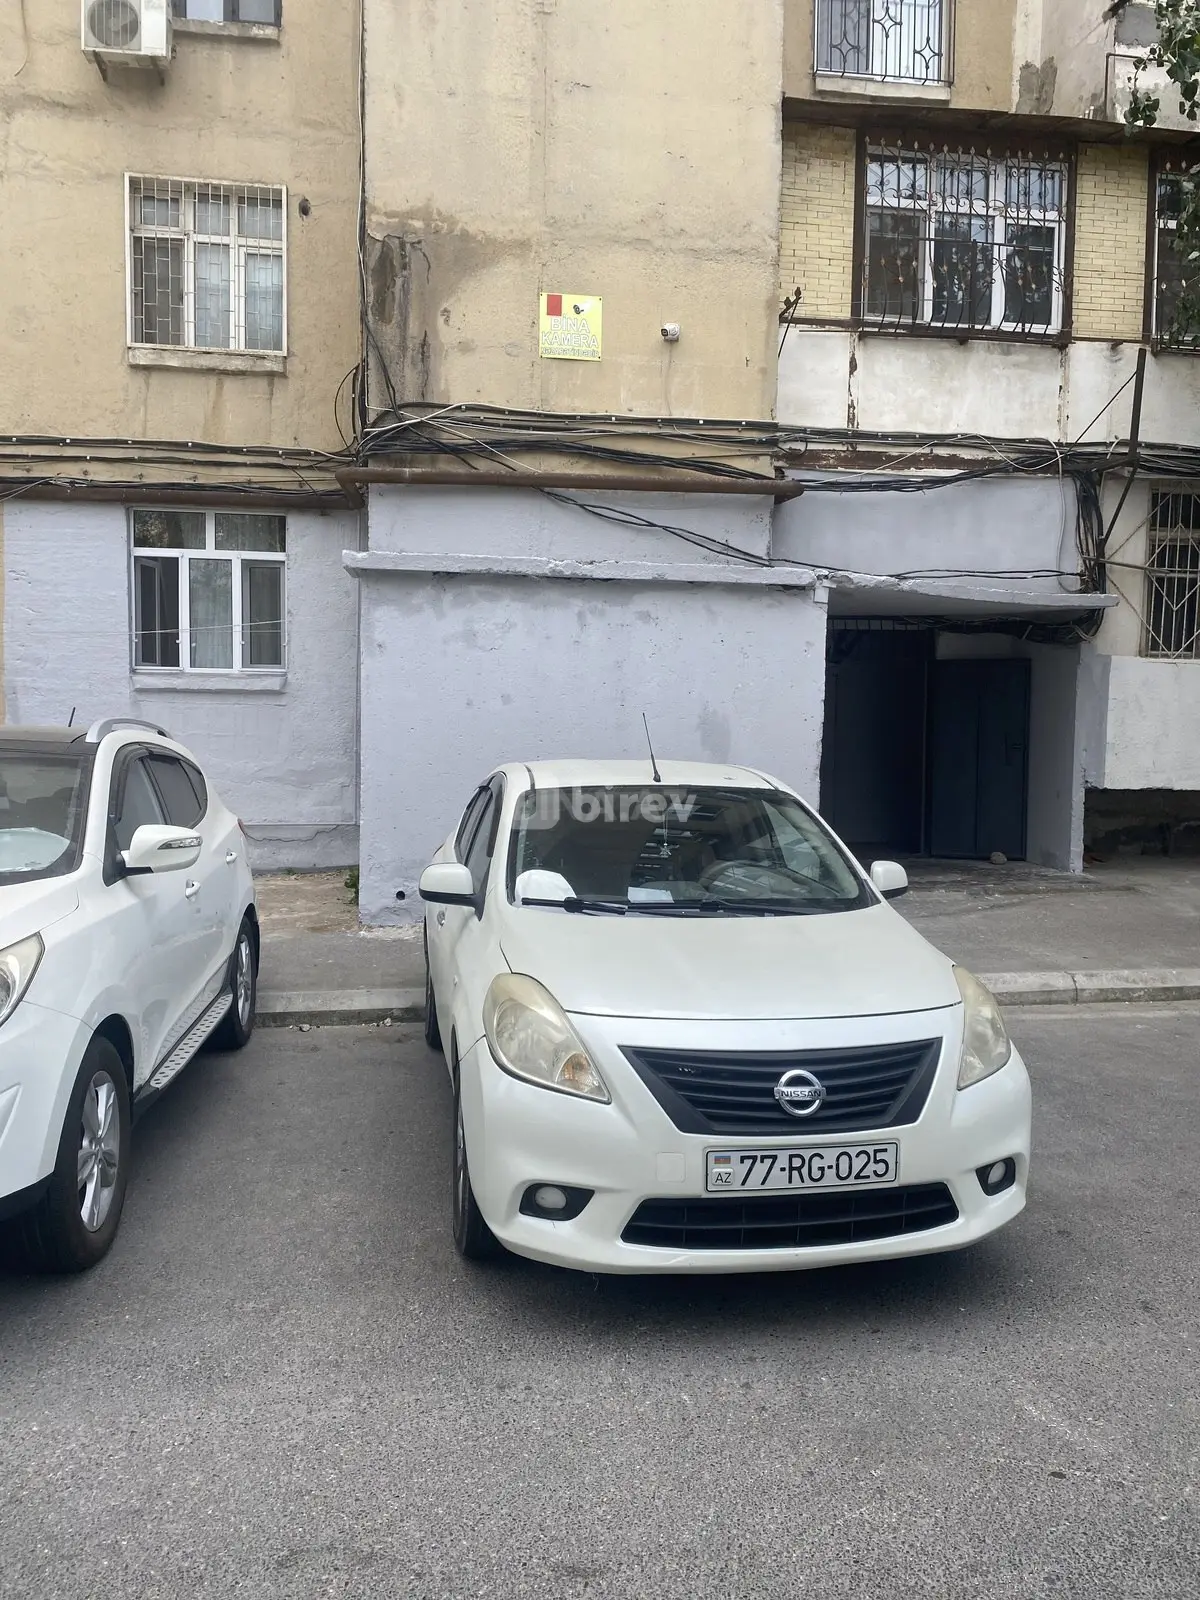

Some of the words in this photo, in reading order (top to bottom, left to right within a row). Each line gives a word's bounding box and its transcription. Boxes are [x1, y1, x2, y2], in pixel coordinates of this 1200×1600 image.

[551, 314, 590, 333] BİNA
[541, 331, 599, 348] KAMERA
[781, 1090, 821, 1098] NISSAN
[714, 1172, 732, 1184] AZ
[739, 1148, 890, 1186] 77-RG-025
